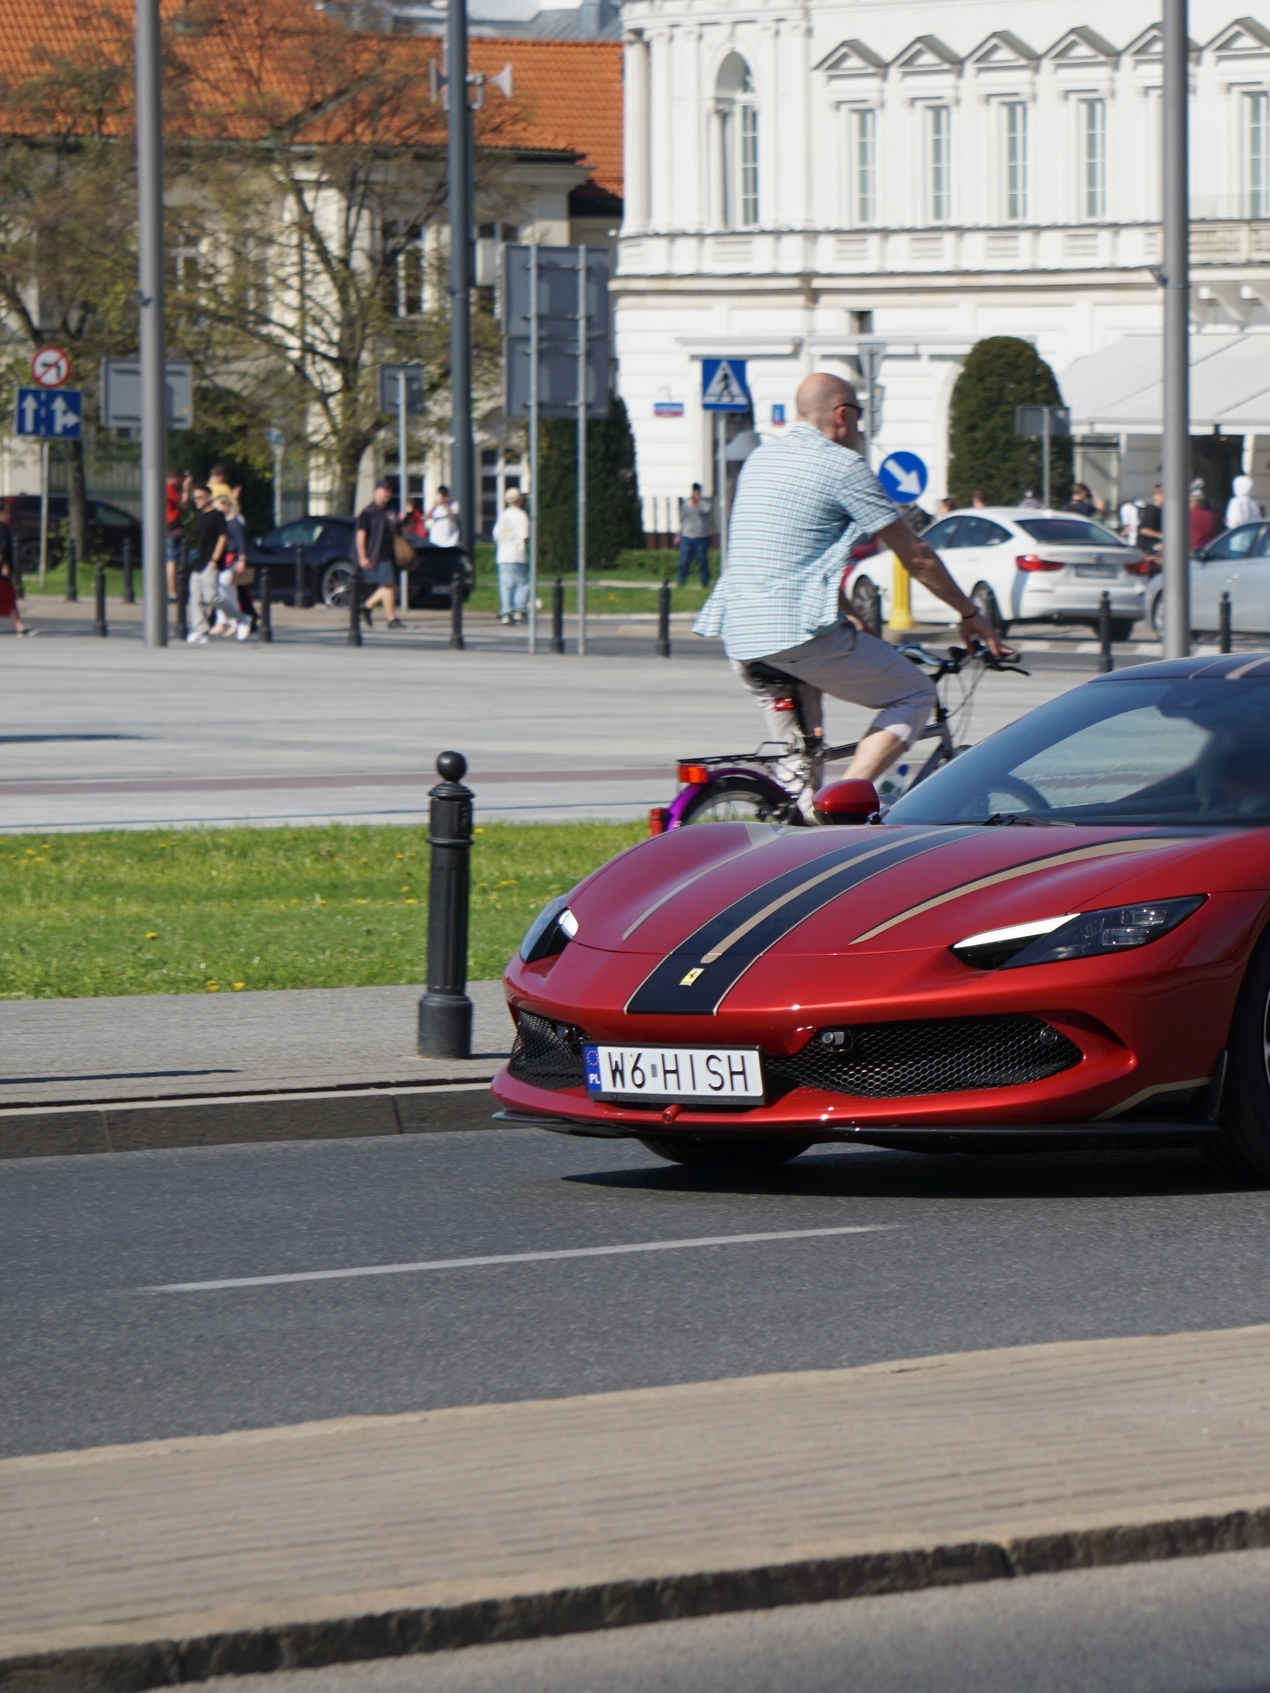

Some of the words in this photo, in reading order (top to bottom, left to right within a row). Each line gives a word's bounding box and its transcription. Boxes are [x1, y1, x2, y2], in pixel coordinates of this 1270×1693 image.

[589, 1073, 601, 1085] PL
[608, 1052, 646, 1089] W6
[661, 1053, 749, 1092] HISH
